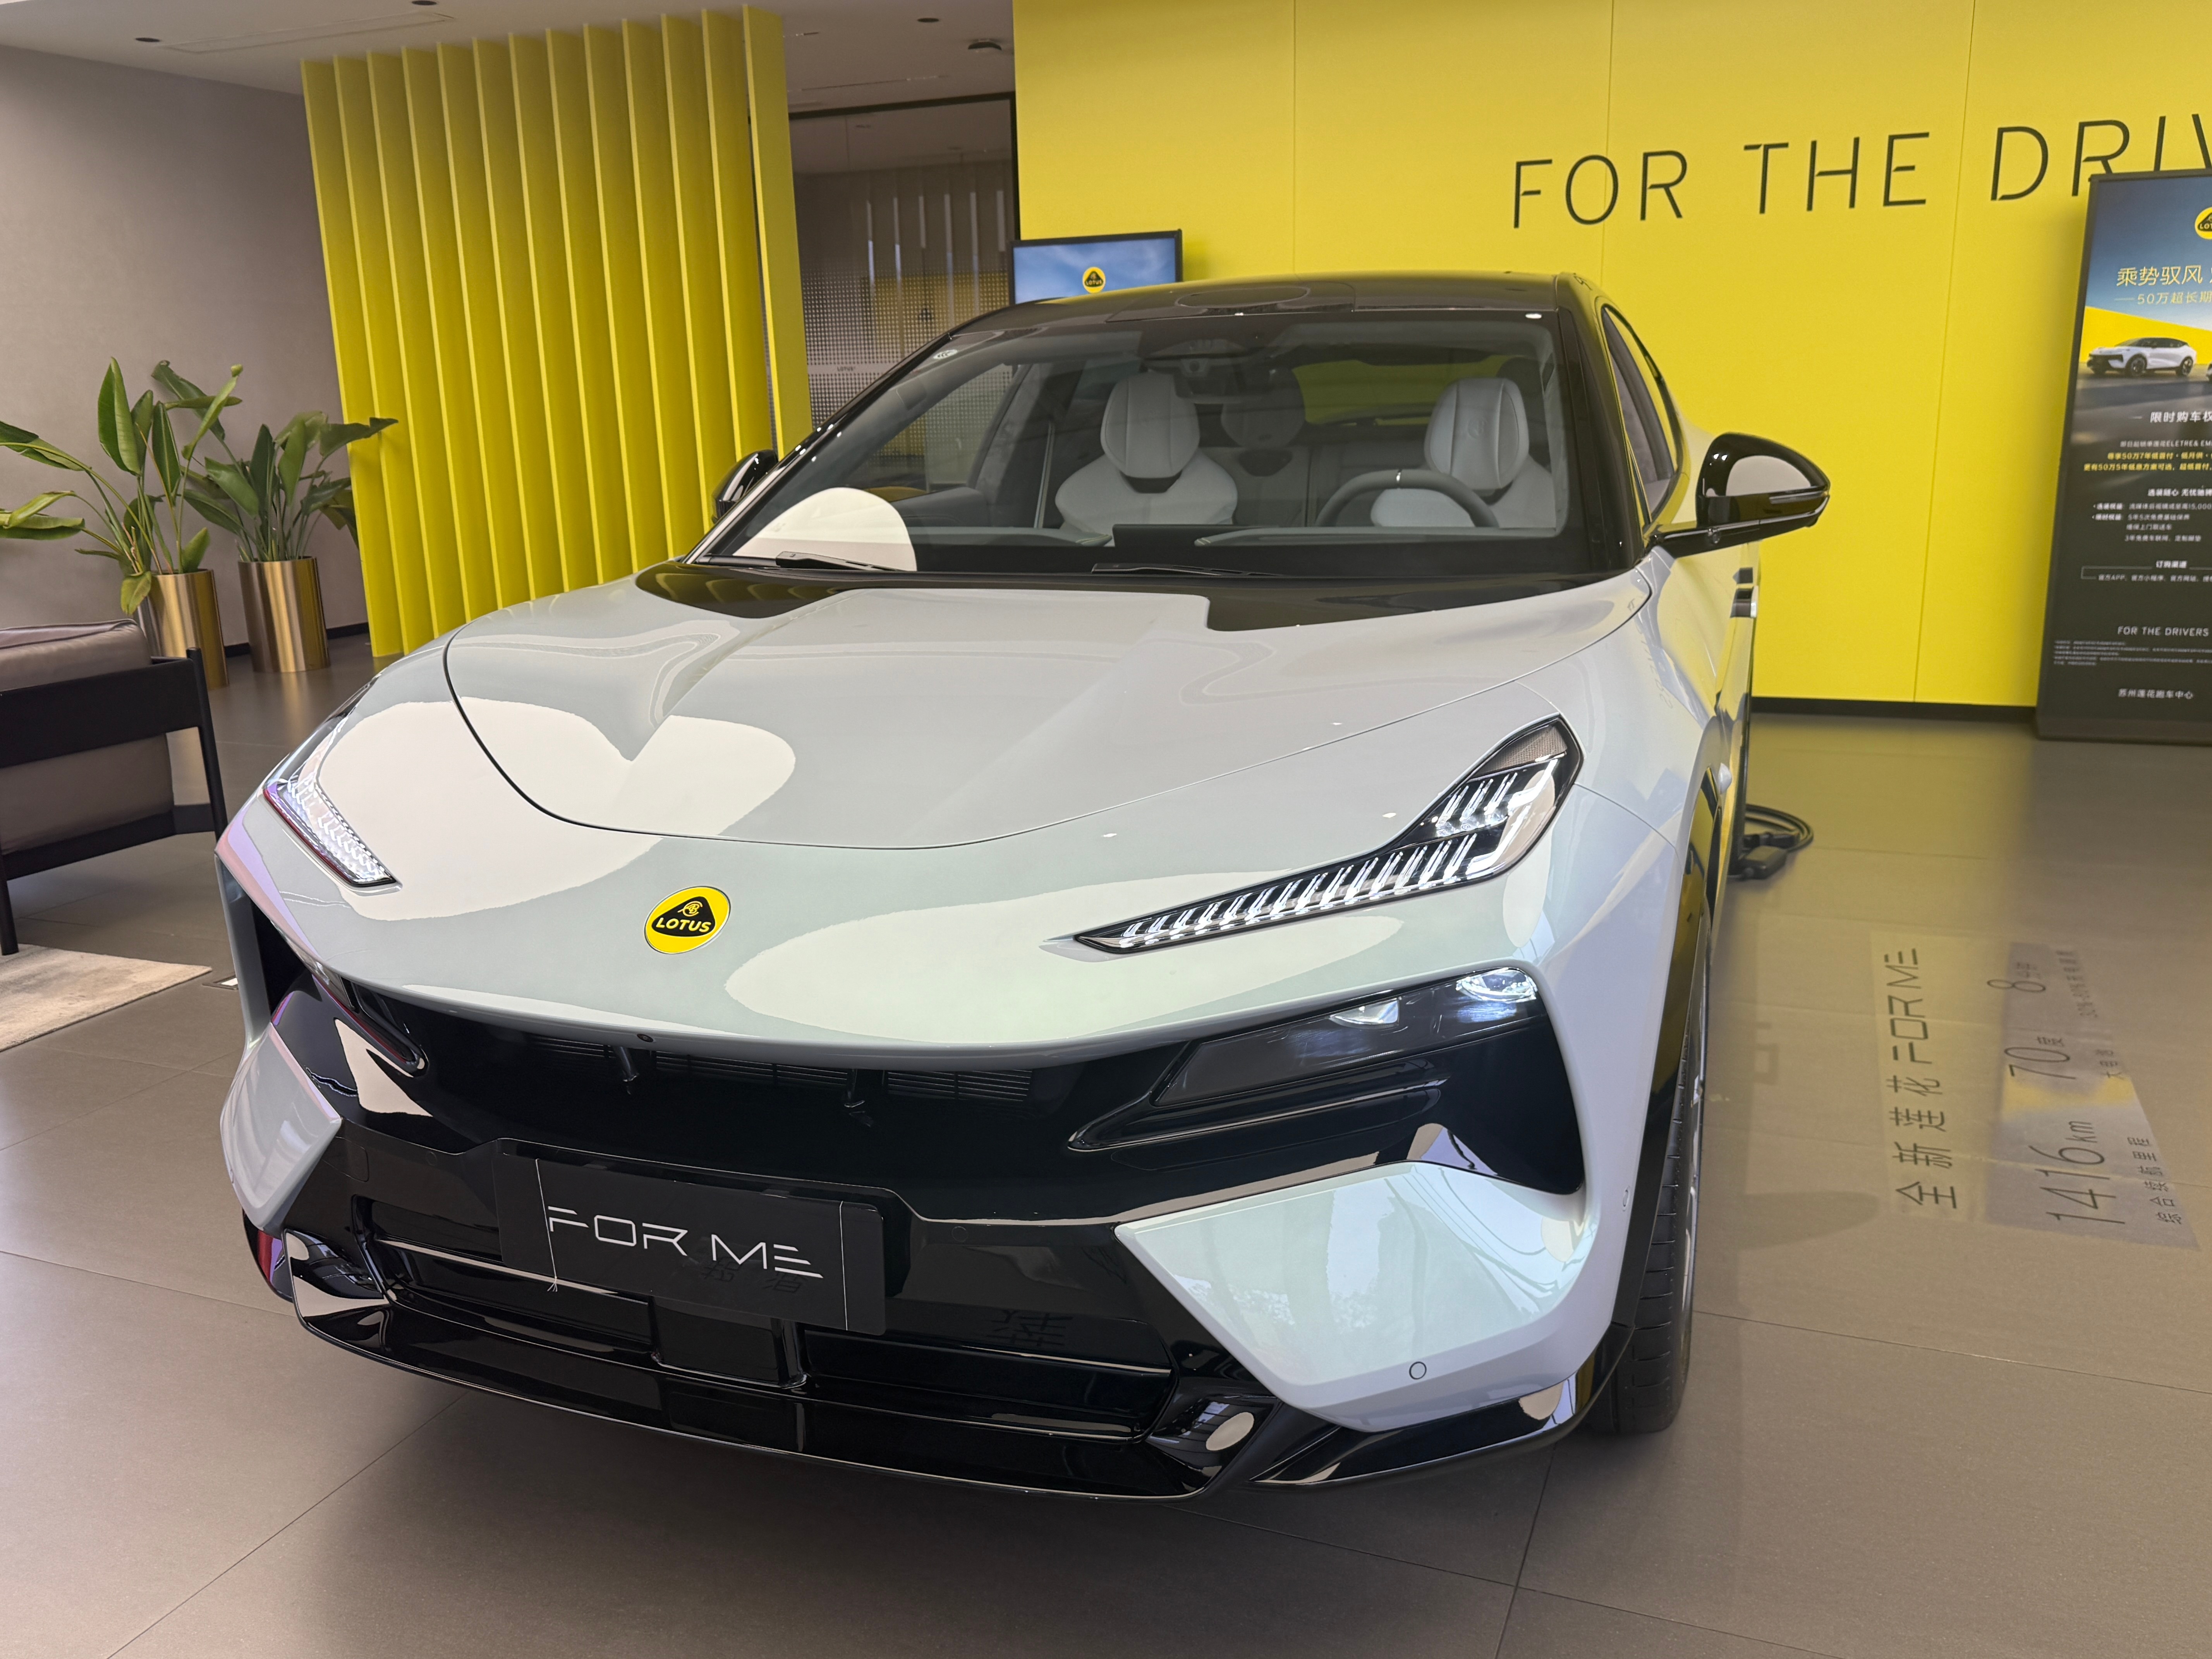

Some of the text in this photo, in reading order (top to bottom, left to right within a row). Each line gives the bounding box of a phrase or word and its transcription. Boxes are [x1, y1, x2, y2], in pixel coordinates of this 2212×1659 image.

[1513, 149, 1688, 228] FOR
[1743, 132, 1930, 215] THE
[2116, 265, 2203, 287] 乘势驭风
[2117, 625, 2209, 637] FOR THE DRIVERS
[656, 917, 711, 933] LOTUS
[1884, 948, 1957, 1209] 全新莲花 FOR ME
[548, 1205, 688, 1257] FOR
[711, 1234, 824, 1279] ME
